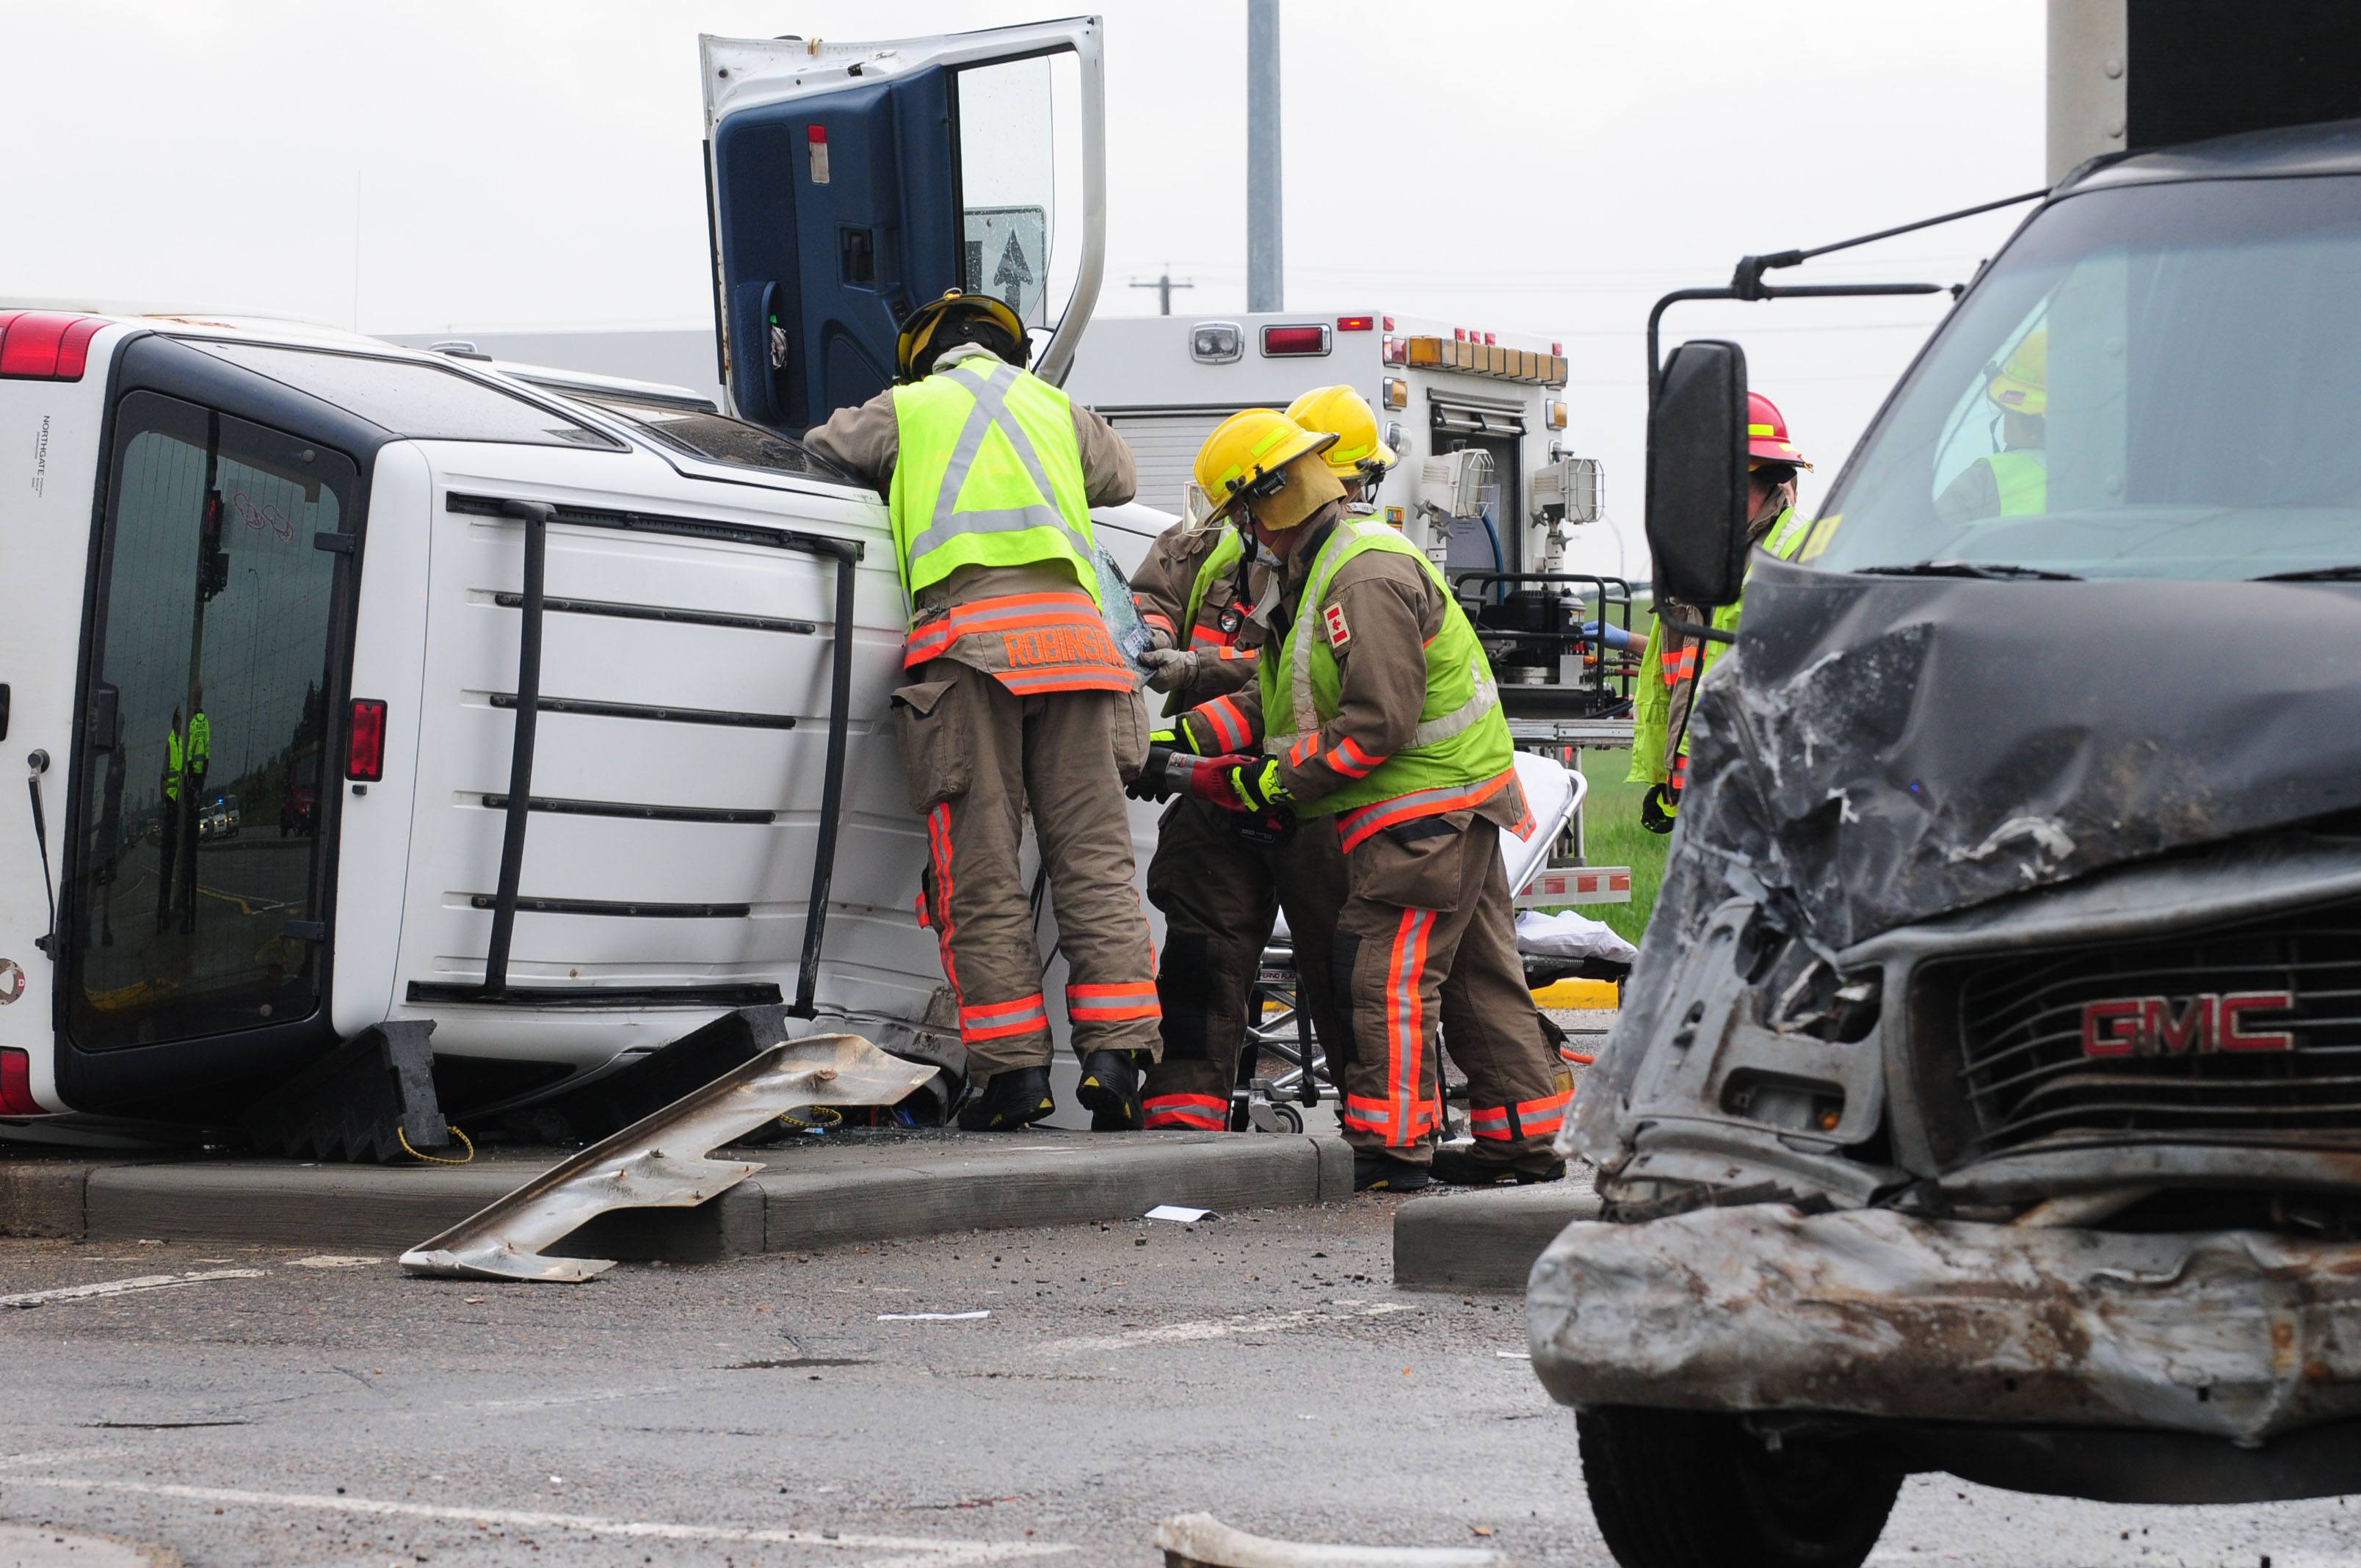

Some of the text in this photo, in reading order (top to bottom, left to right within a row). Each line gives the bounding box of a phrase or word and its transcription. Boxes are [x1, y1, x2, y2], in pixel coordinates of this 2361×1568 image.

[37, 415, 50, 476] NORTHGATE
[1004, 627, 1124, 667] ROBINSON
[2083, 990, 2293, 1058] GMC
